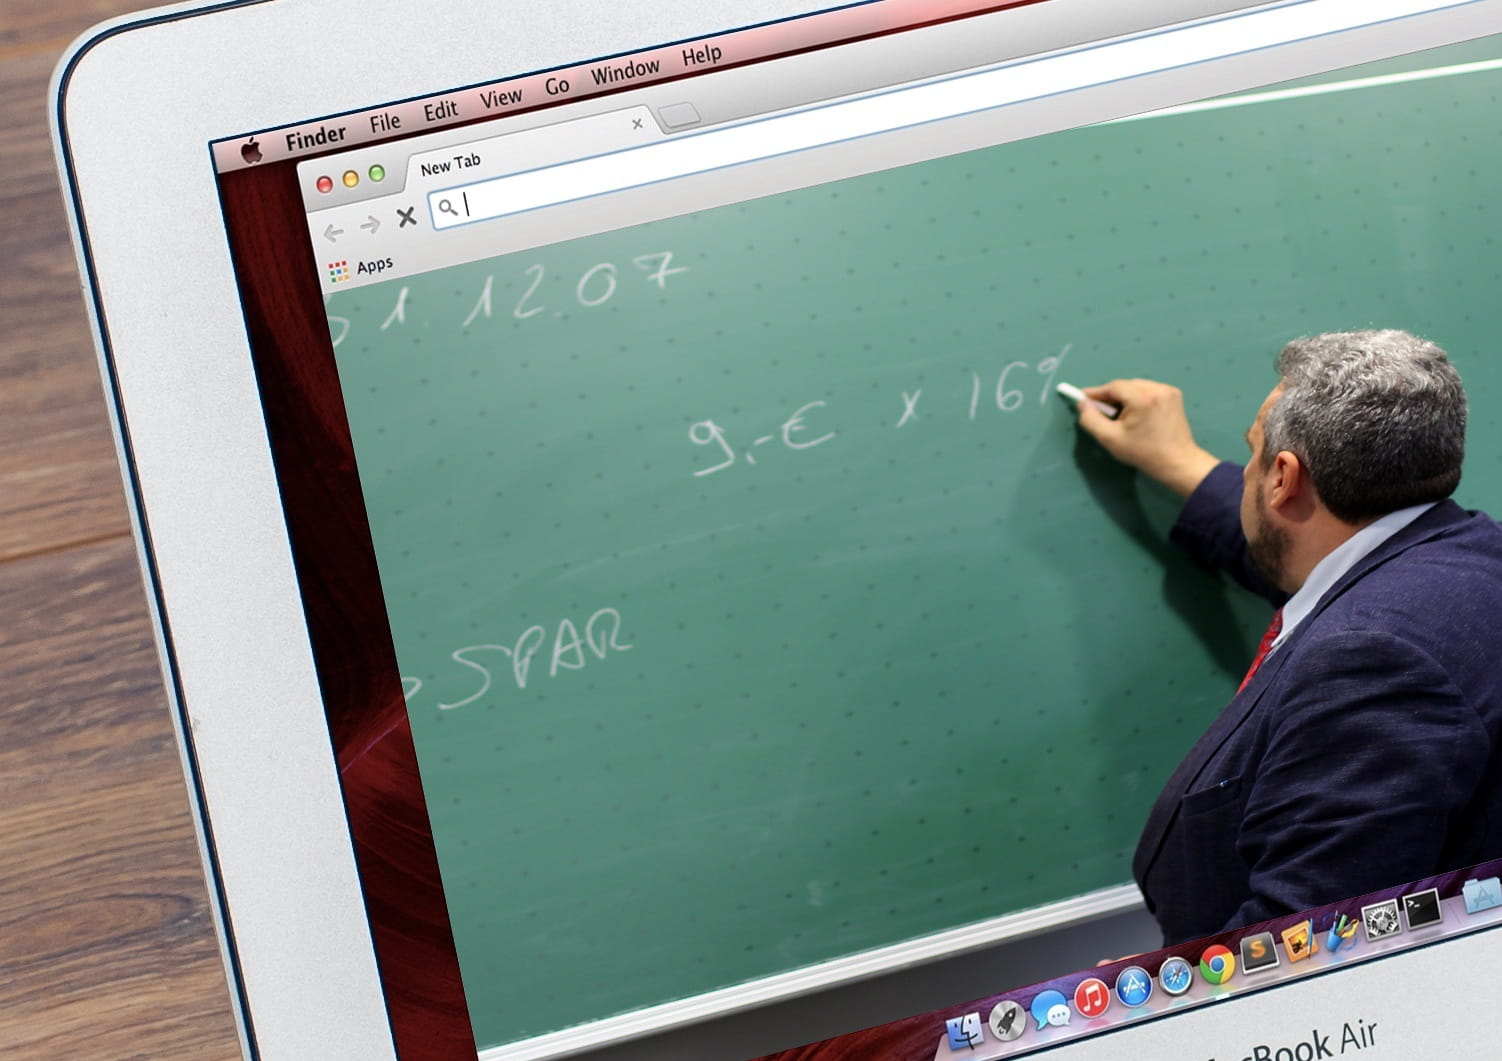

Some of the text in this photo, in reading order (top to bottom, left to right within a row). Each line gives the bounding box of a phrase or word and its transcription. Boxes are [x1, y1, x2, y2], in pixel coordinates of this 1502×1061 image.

[286, 44, 722, 151] Finder File Edit View Go Window Help
[421, 153, 481, 177] New Tab
[357, 255, 393, 275] Apps
[437, 607, 634, 710] SPAR
[1340, 1019, 1377, 1054] Air
